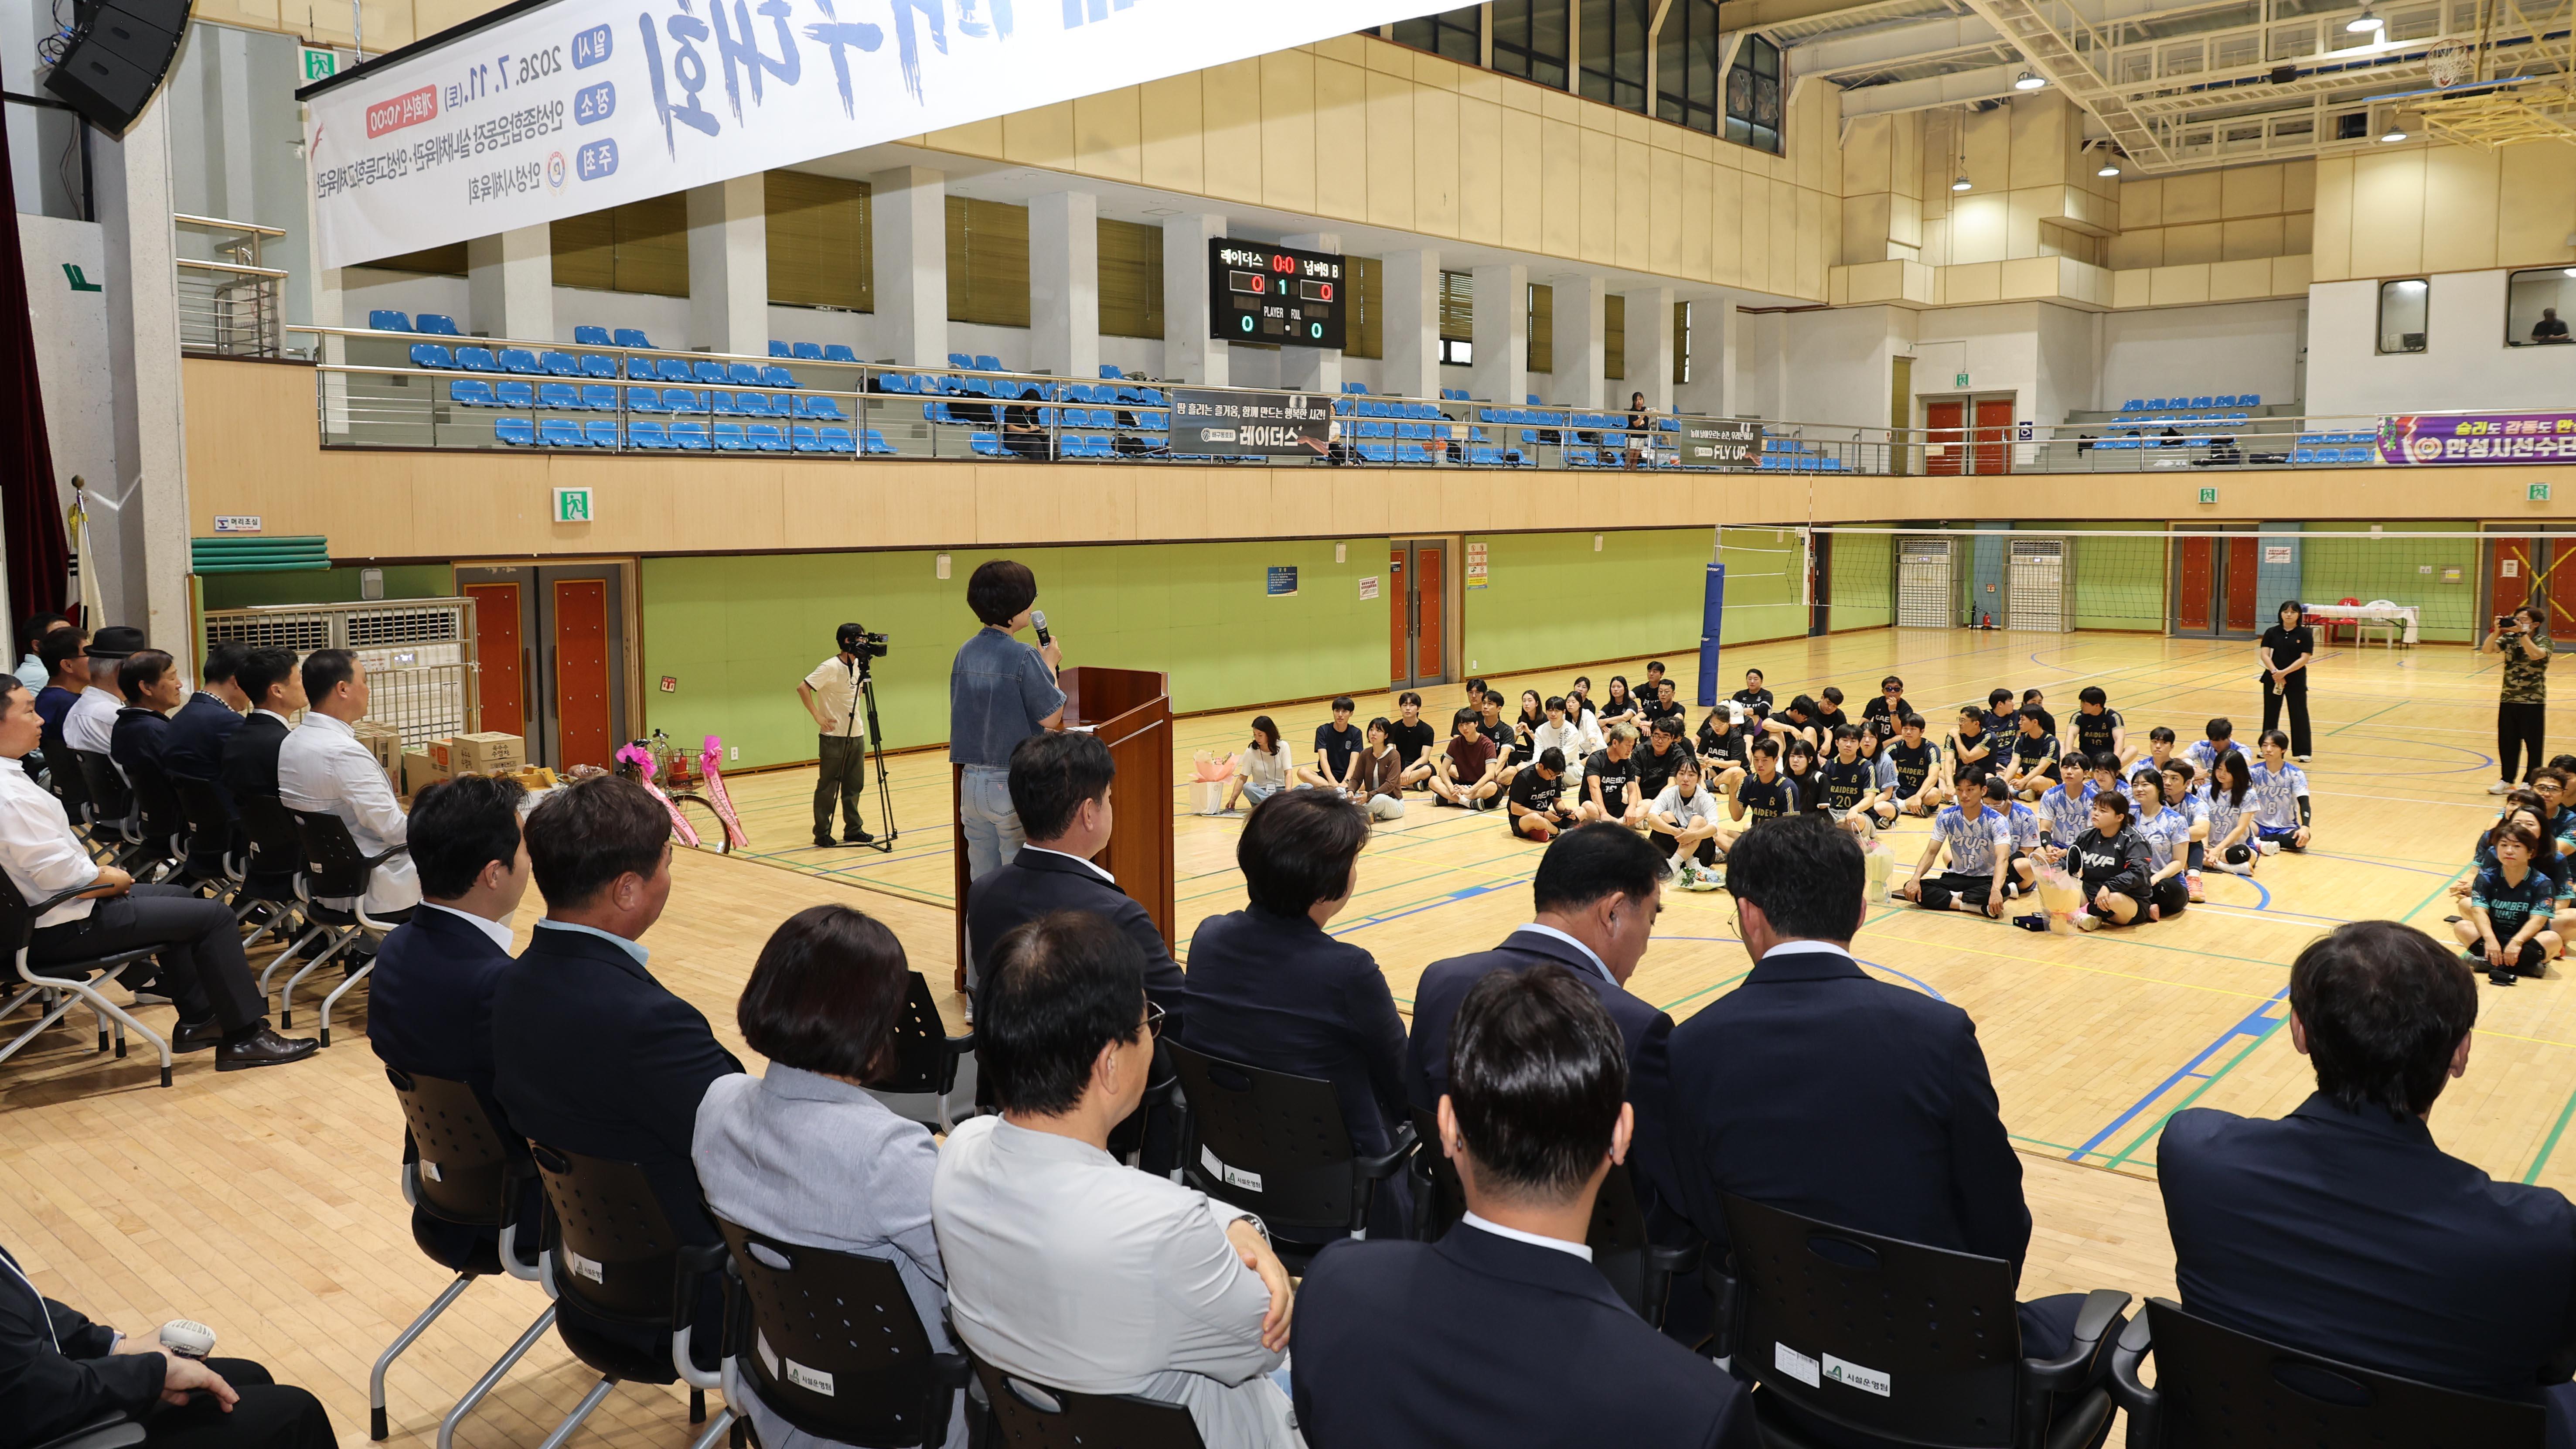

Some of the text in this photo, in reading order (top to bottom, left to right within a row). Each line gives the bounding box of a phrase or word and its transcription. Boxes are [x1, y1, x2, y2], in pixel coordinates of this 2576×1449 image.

[1220, 249, 1263, 266] 레이더스
[1273, 254, 1295, 274] 0:0
[1252, 276, 1331, 300] 0 1 0
[1264, 306, 1301, 320] PLAYER FOUL
[1242, 315, 1322, 338] 0 0
[1177, 402, 1185, 414] 땀
[1188, 403, 1212, 416] 흘리는
[1214, 405, 1240, 419] 즐거움,
[1243, 406, 1258, 418] 함께
[1261, 407, 1282, 419] 만드는
[1285, 408, 1307, 420] 행복한
[2455, 419, 2576, 436] 승리도 감동도 안
[1240, 425, 1298, 447] 레이더스
[1714, 445, 1746, 460] FLY UP
[1881, 723, 1891, 735] 18
[1898, 766, 1925, 775] RAIDERS
[1601, 776, 1626, 784] DAESO
[1530, 789, 1555, 800] DAESO
[1830, 785, 1858, 794] RAIDERS
[2256, 784, 2290, 798] MVP
[1836, 795, 1852, 807] 20
[2267, 801, 2277, 815] 8
[2210, 805, 2240, 817] MVP
[2215, 820, 2229, 835] 27
[1950, 835, 1988, 850] MVP
[2065, 830, 2075, 842] 6
[1962, 854, 1976, 870] 15
[2082, 851, 2115, 867] MVP
[2491, 899, 2529, 912] NUMBER
[2494, 909, 2518, 920] NINE
[802, 1375, 831, 1391] 시설운영팀
[1847, 1374, 1888, 1392] 시설운영팀
